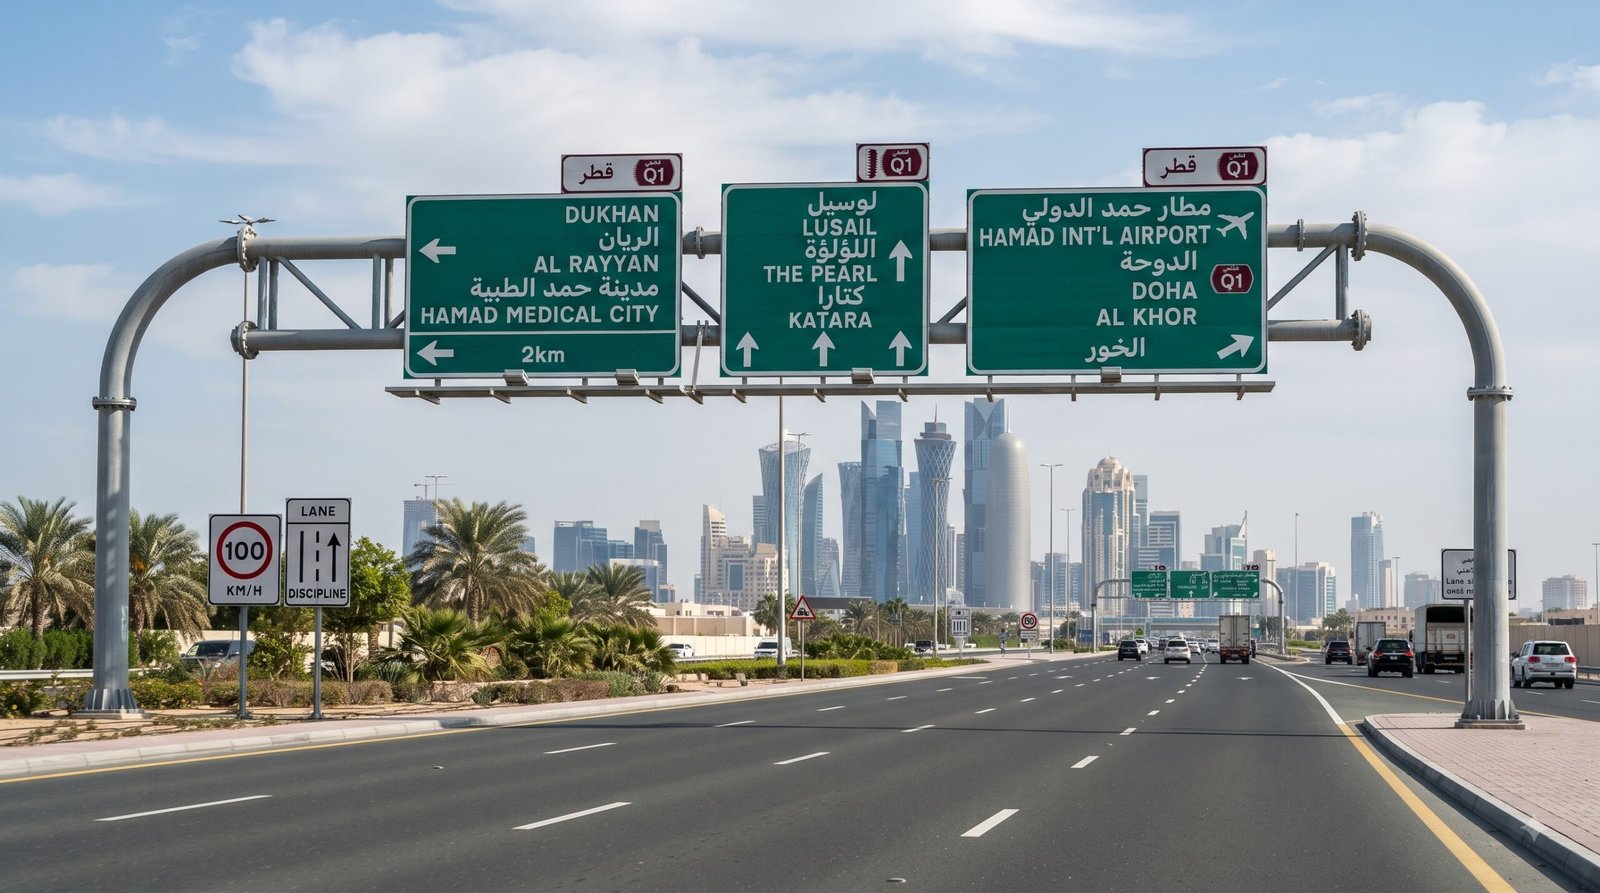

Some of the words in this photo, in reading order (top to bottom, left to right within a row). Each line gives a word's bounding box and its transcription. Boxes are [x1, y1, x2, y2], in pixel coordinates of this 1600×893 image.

[579, 163, 613, 185] قطر
[891, 157, 911, 174] Q1
[1160, 155, 1196, 179] قطر
[1227, 160, 1248, 178] Q1
[644, 168, 663, 184] Q1
[808, 191, 876, 216] لوسيل
[1023, 197, 1092, 226] الدولي
[1102, 200, 1151, 217] حمد
[1157, 196, 1211, 221] مطار
[566, 205, 658, 223] DUKHAN
[803, 218, 877, 236] LUSAIL
[980, 227, 1054, 246] HAMAD
[1120, 225, 1211, 244] AIRPORT
[599, 227, 658, 251] الريان
[805, 238, 875, 263] اللؤلؤة
[534, 256, 561, 273] AL
[570, 255, 658, 272] RAYYAN
[1121, 250, 1196, 276] الدوحة
[763, 266, 803, 282] THE
[812, 265, 877, 282] PEARL
[1221, 274, 1241, 290] Q1
[471, 277, 535, 302] الطبية
[543, 280, 591, 297] حمد
[599, 277, 658, 301] مدينة
[819, 285, 864, 310] كتارا
[1133, 281, 1197, 299] DOHA
[421, 307, 497, 324] HAMAD
[507, 306, 601, 323] MEDICAL
[610, 305, 658, 322] CITY
[790, 312, 872, 328] KATARA
[1096, 308, 1124, 326] AL
[1134, 308, 1196, 325] KHOR
[522, 346, 564, 362] 2km
[1085, 337, 1144, 362] الخور
[302, 506, 335, 516] LANE
[225, 542, 264, 560] 100
[227, 585, 261, 596] KM/H
[289, 589, 346, 598] DISCIPLINE
